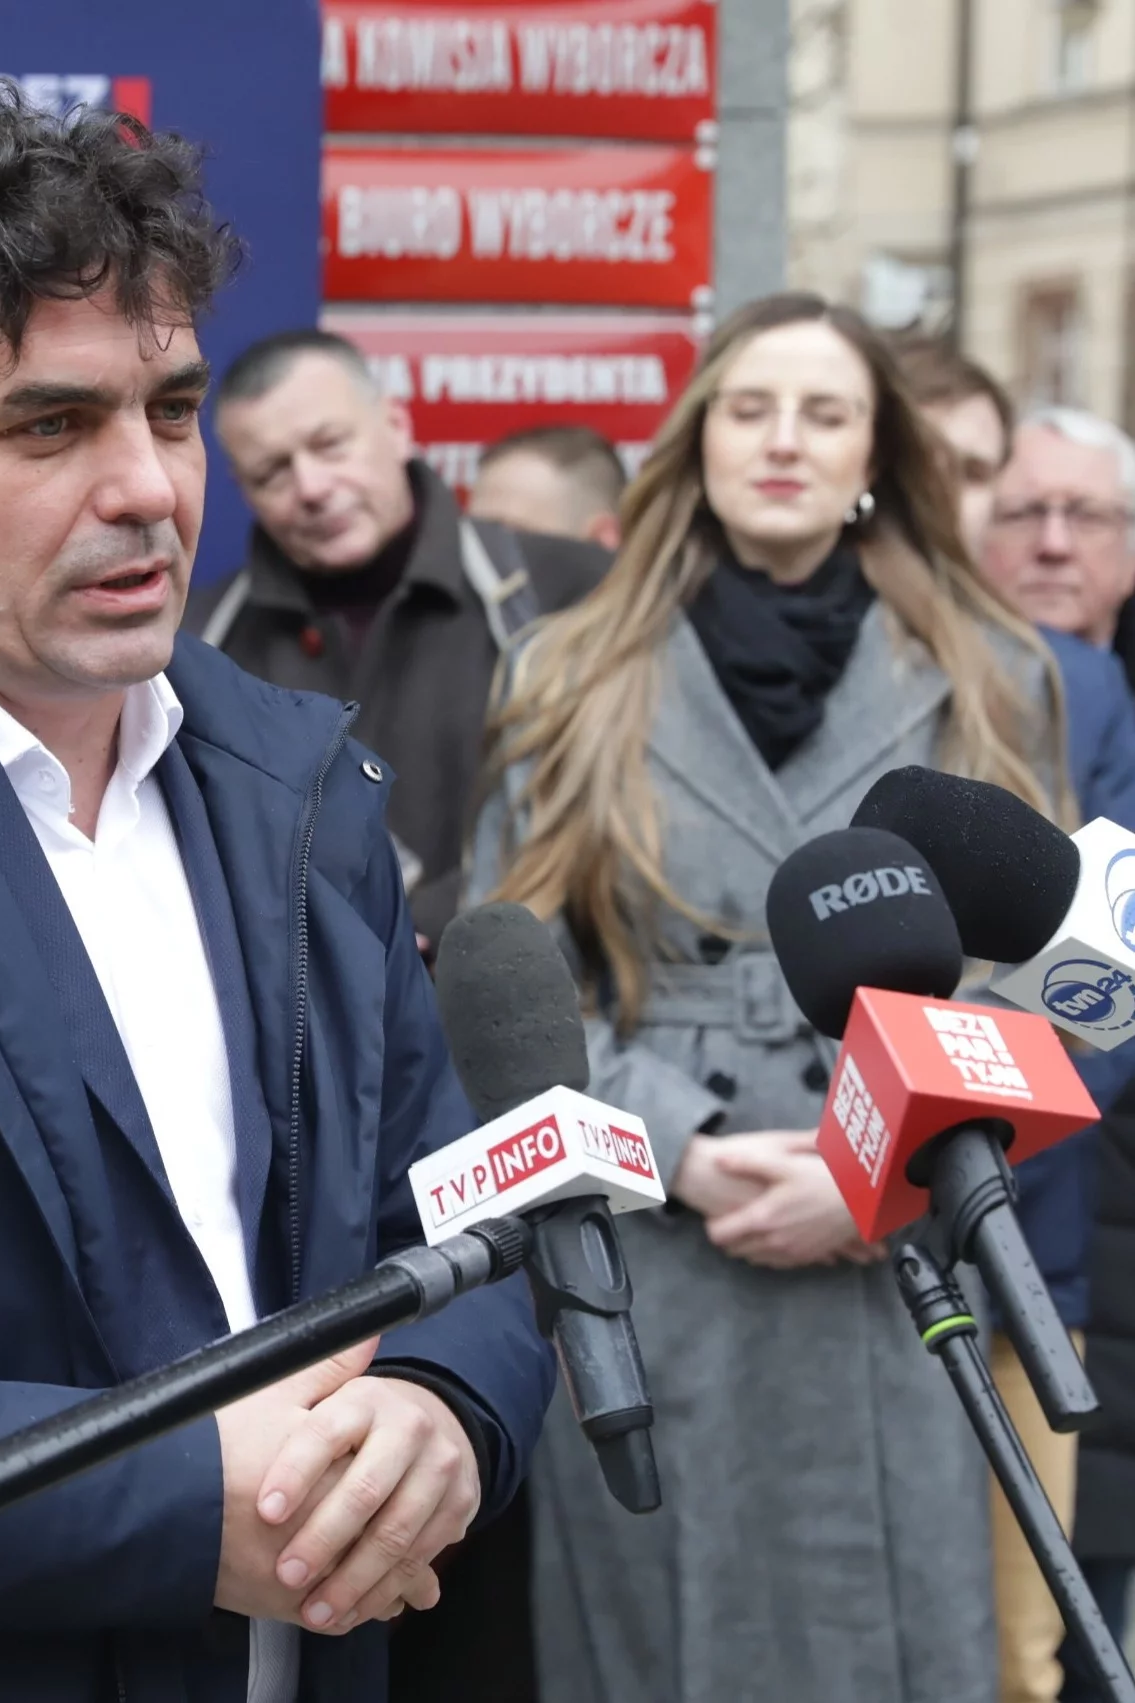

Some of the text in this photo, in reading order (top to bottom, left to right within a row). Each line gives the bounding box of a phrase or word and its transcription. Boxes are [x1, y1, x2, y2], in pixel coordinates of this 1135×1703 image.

[518, 23, 708, 96] WYBORCZA
[338, 185, 675, 262] BIURO WYBORCZE
[420, 353, 667, 404] PREZYDENTA
[809, 866, 932, 921] RØDE
[1052, 985, 1105, 1015] tvn
[430, 1125, 559, 1216] TVP INFO
[578, 1120, 651, 1172] TVP INFO
